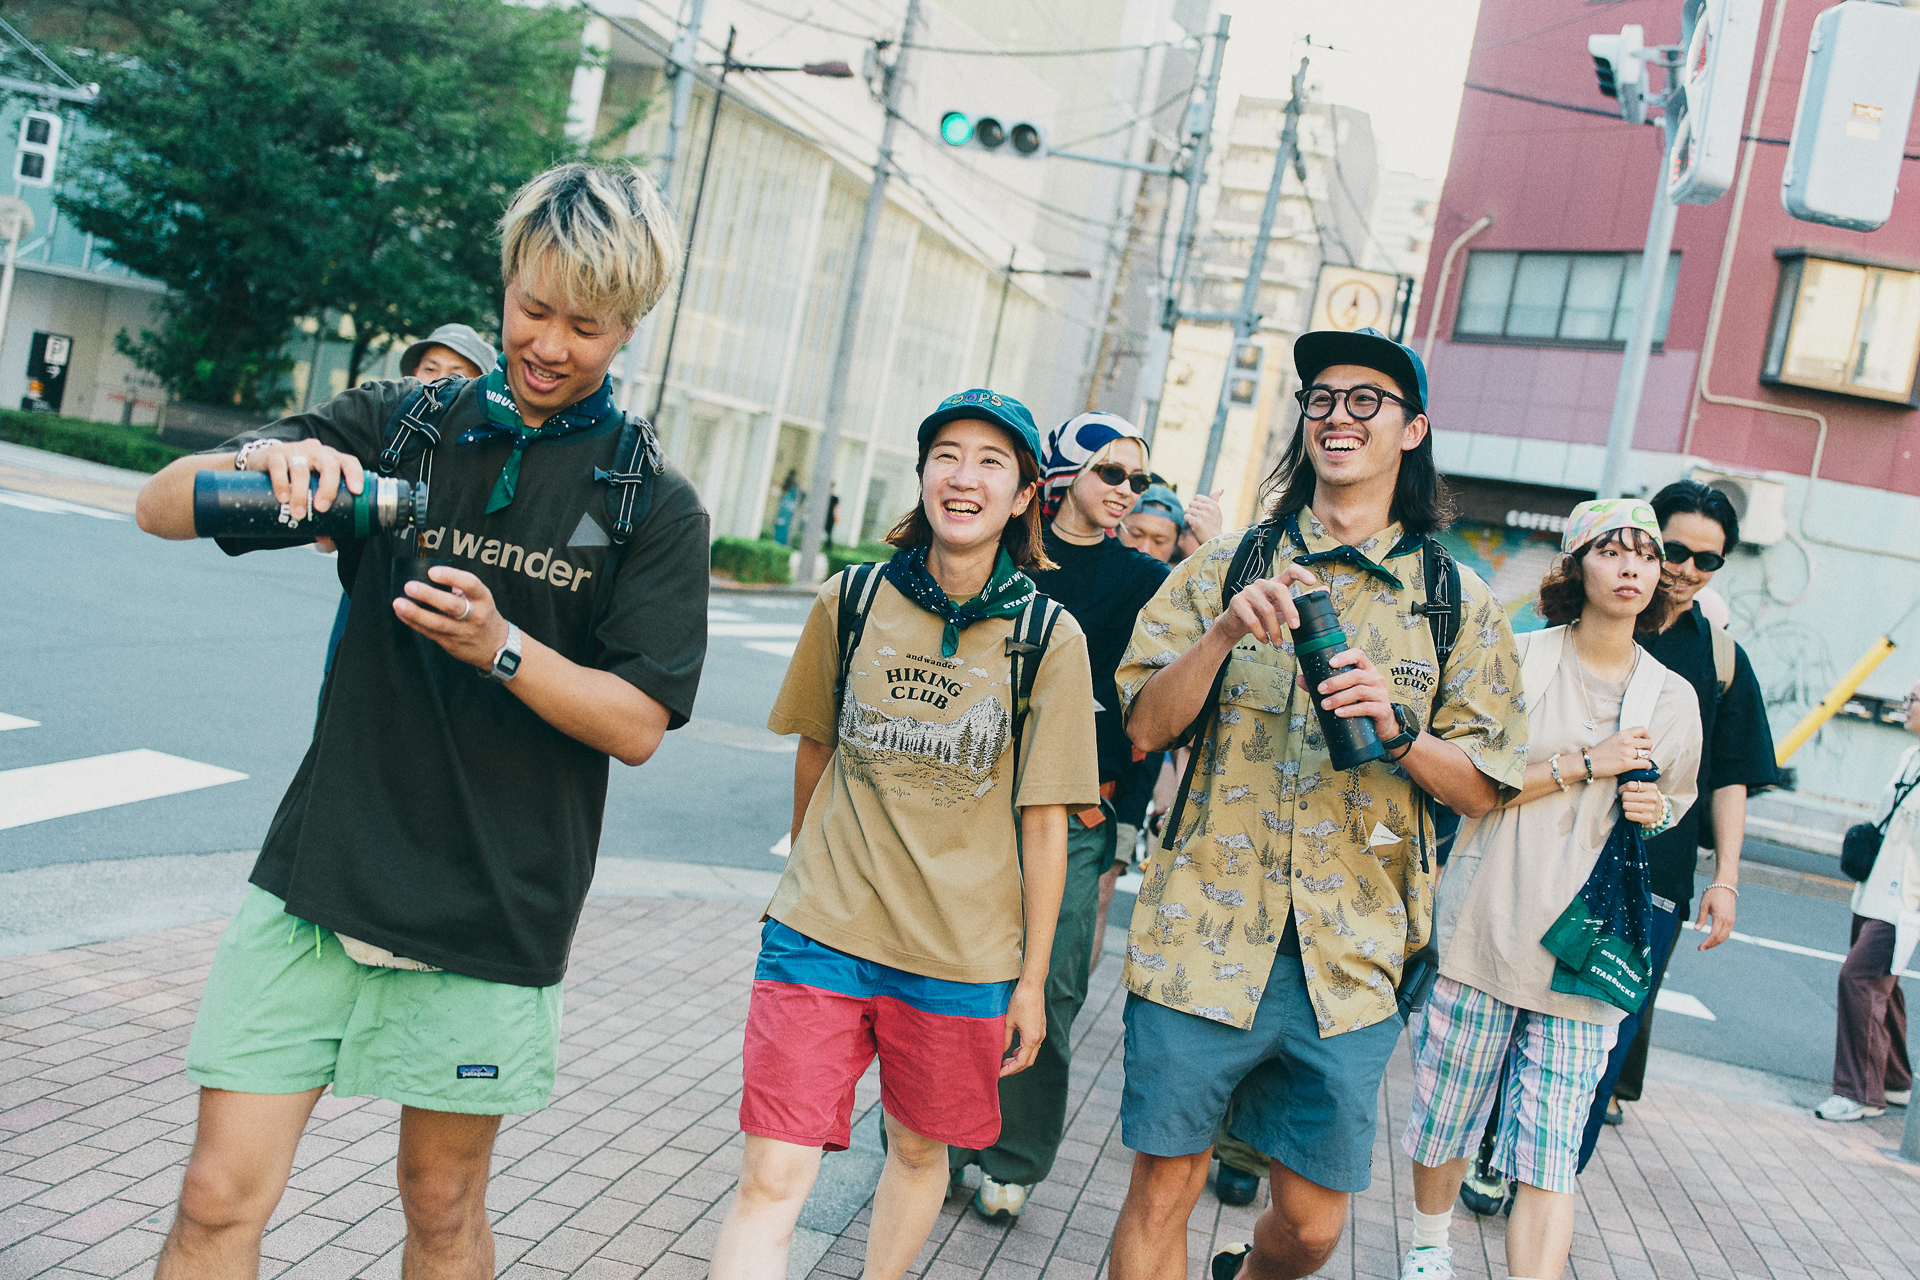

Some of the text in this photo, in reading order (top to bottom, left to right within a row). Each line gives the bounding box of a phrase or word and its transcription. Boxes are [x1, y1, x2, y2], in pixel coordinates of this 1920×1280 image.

[452, 528, 592, 592] wander
[998, 577, 1013, 593] and
[906, 653, 957, 670] and wander
[885, 667, 964, 698] HIKING
[1390, 666, 1436, 686] HIKING
[1394, 677, 1428, 692] CLUB
[891, 686, 949, 710] CLUB
[1601, 949, 1616, 961] and
[1590, 965, 1636, 999] STARBUCKS
